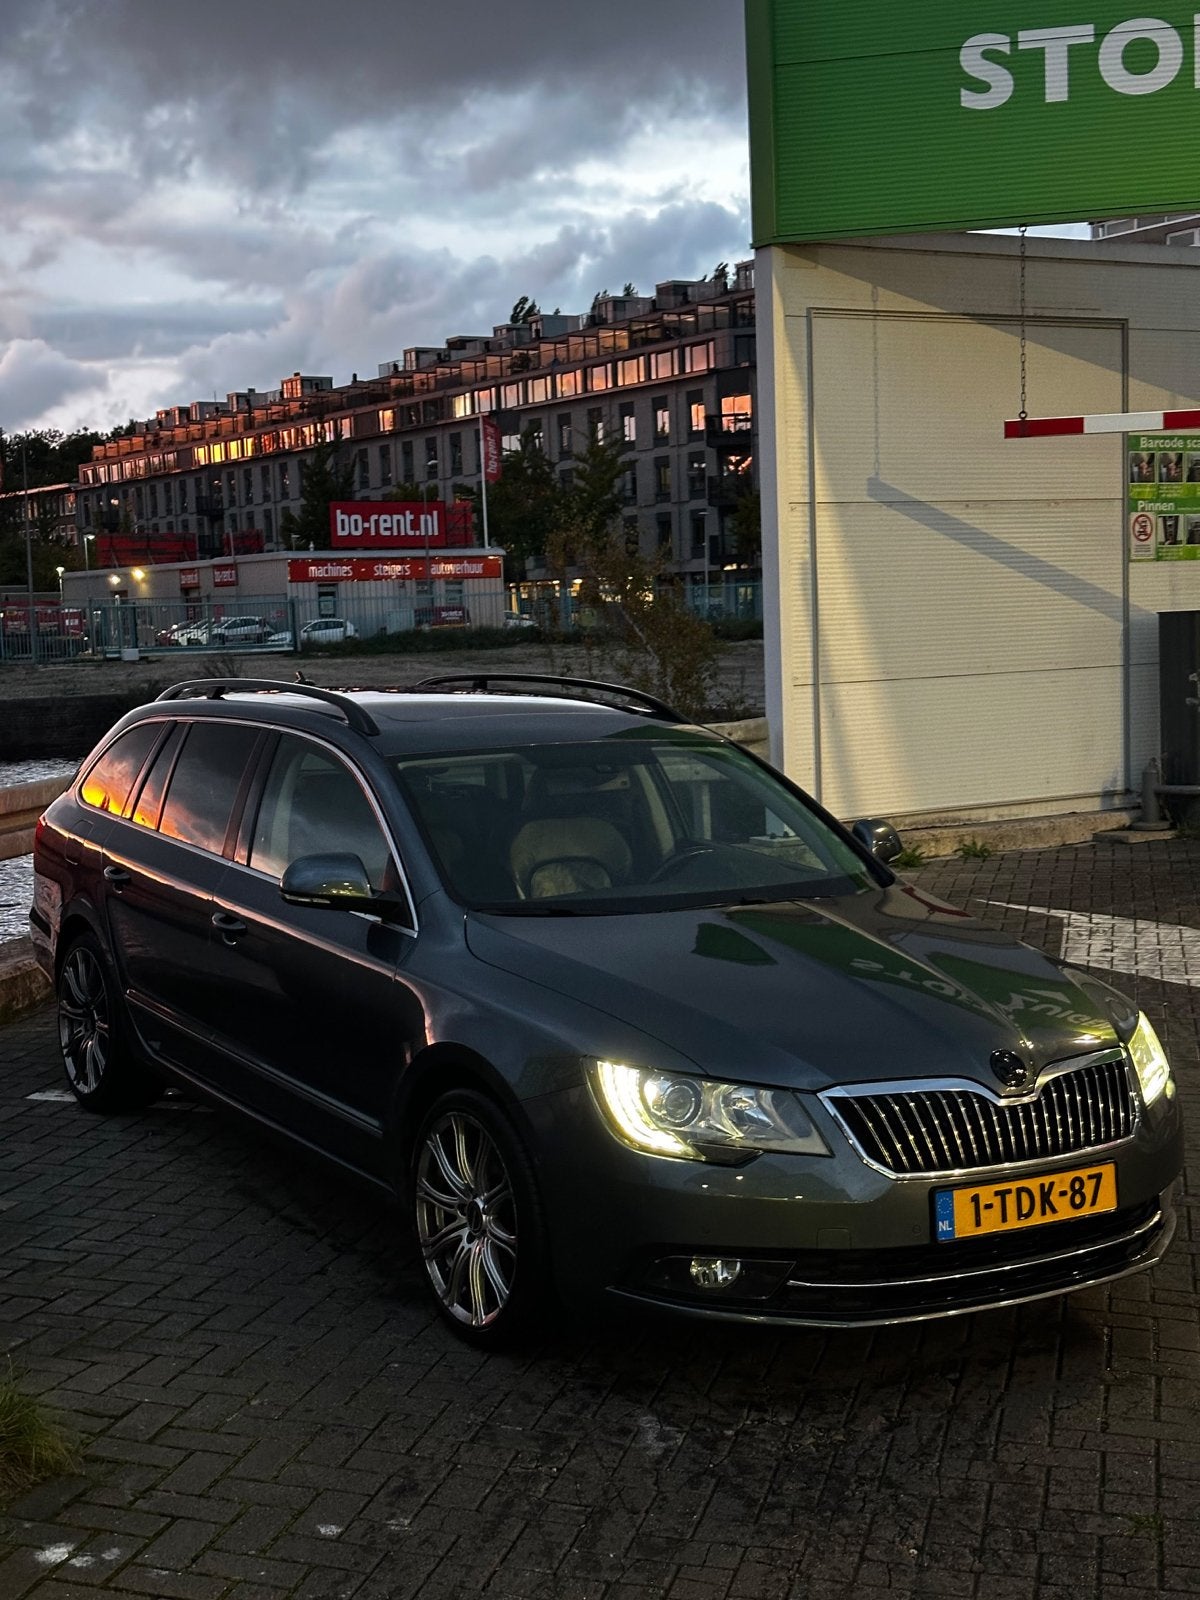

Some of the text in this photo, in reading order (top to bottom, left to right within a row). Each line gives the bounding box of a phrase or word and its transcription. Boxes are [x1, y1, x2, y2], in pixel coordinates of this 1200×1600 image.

[960, 14, 1200, 109] STO
[1140, 437, 1184, 448] Barcode
[1138, 501, 1175, 511] Pinnen
[336, 509, 439, 536] bo-rent.nl
[308, 563, 353, 577] machines
[373, 562, 411, 578] steigers
[430, 561, 484, 575] autoverhuur
[970, 1172, 1103, 1228] 1-TDK-87
[938, 1220, 953, 1231] NL
